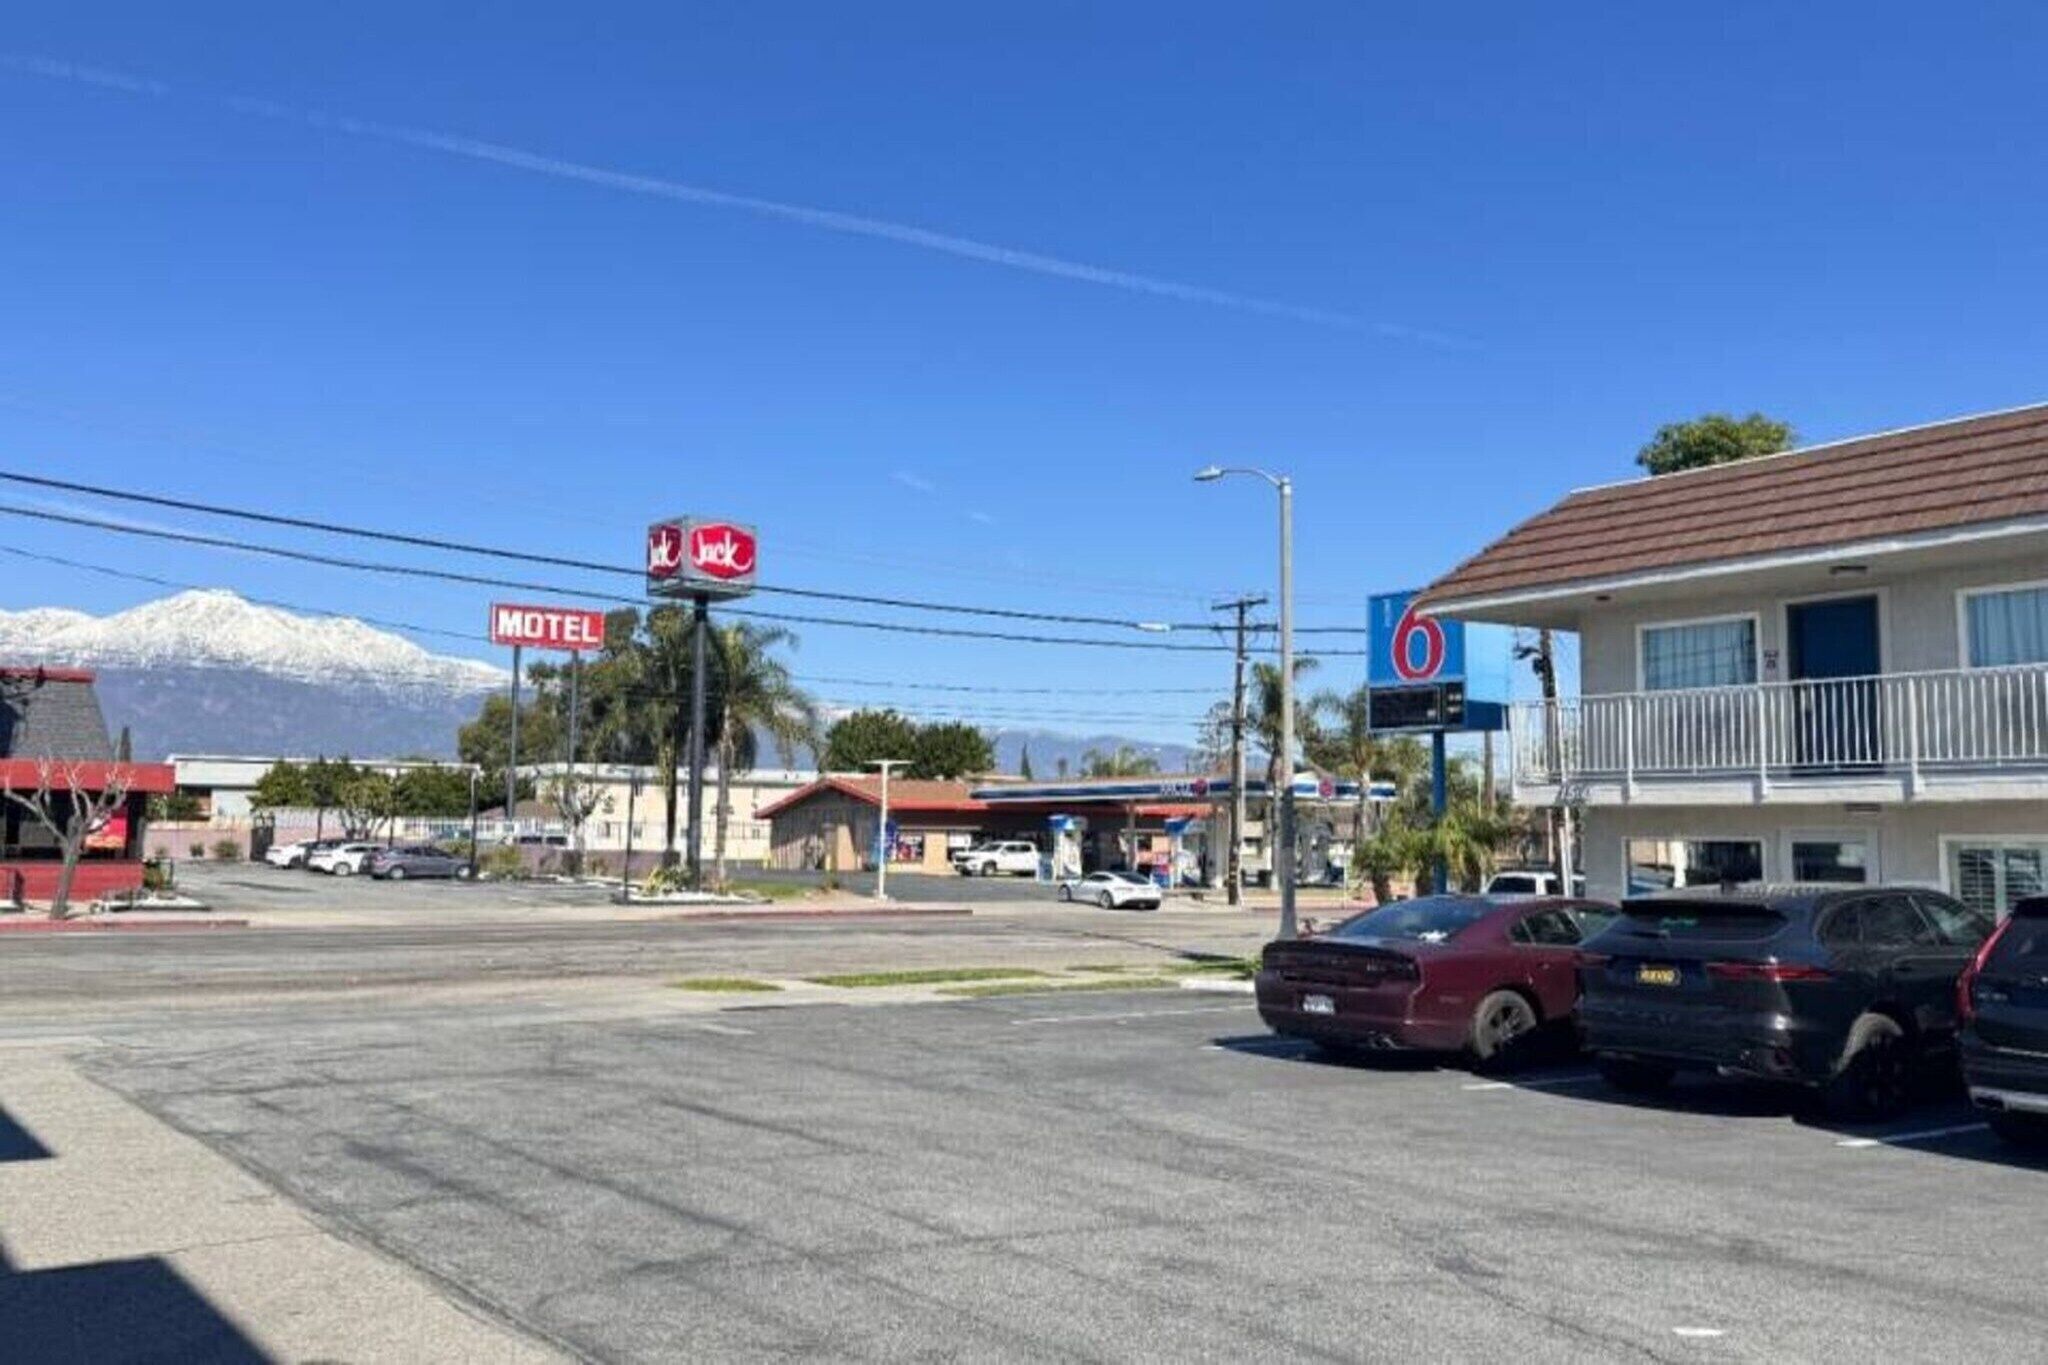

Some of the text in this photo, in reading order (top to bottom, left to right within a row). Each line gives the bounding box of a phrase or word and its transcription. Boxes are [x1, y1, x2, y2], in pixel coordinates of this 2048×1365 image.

[694, 530, 752, 572] Jack
[497, 608, 600, 643] MOTEL
[1391, 597, 1446, 682] 6
